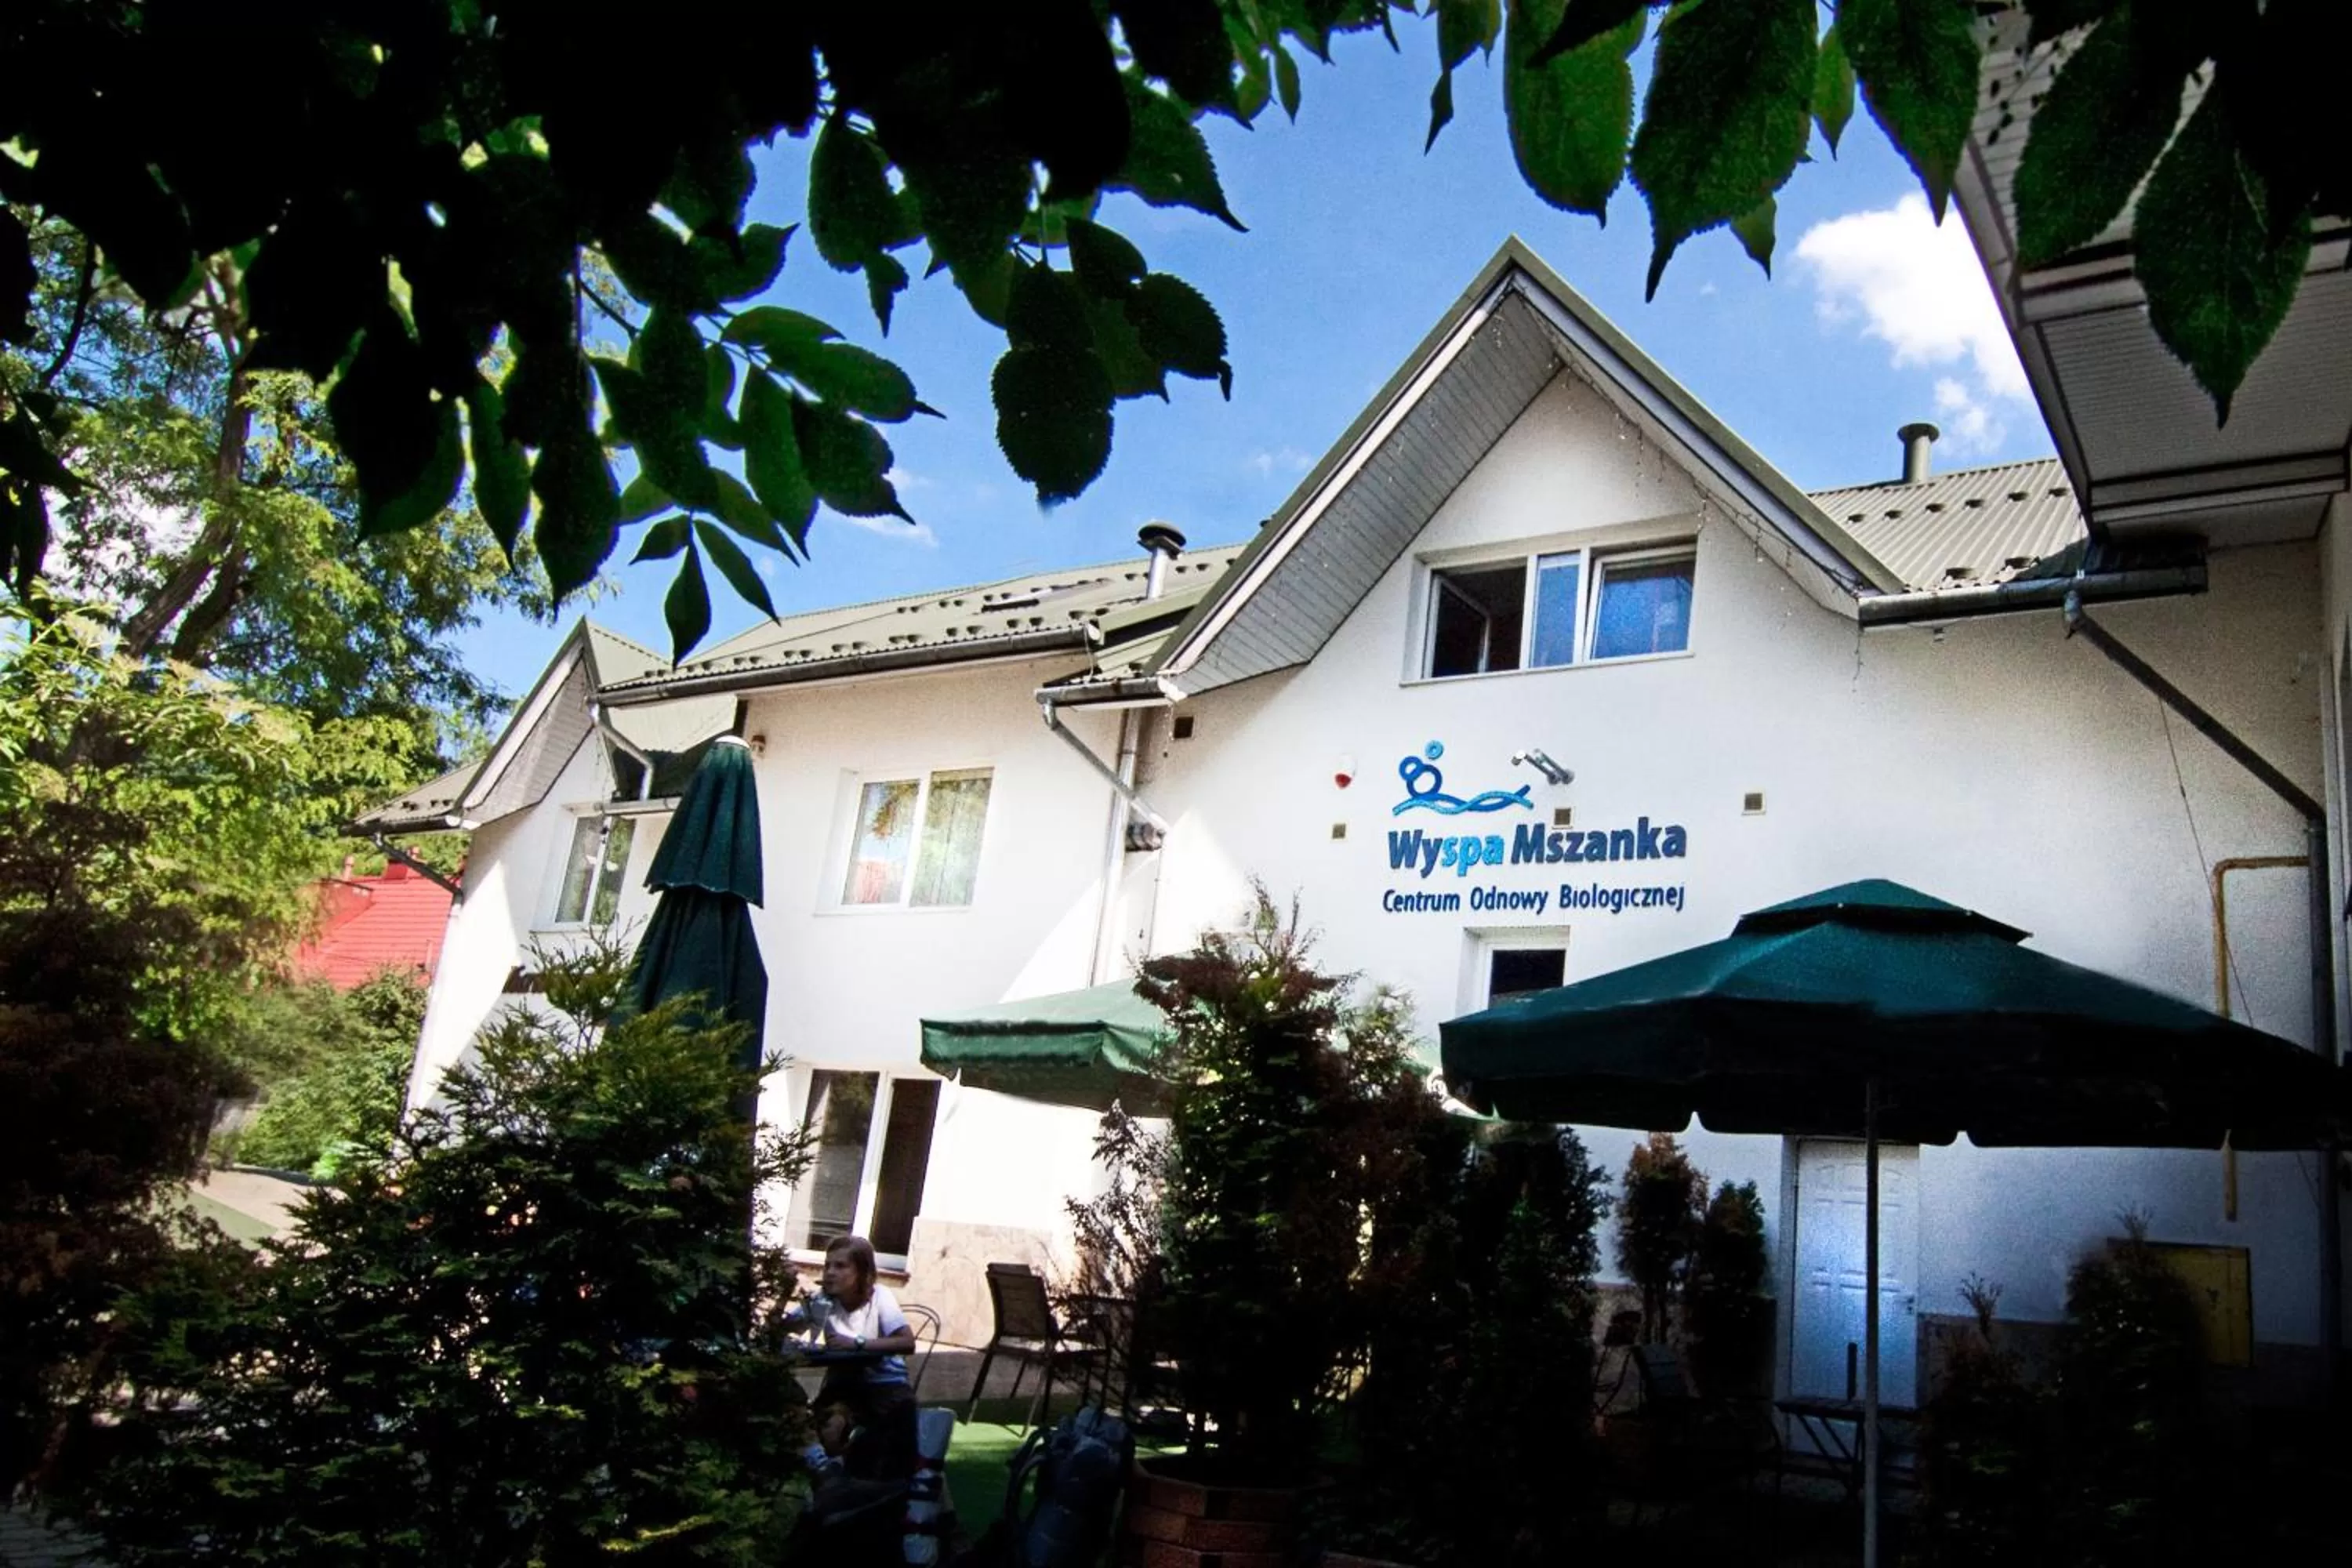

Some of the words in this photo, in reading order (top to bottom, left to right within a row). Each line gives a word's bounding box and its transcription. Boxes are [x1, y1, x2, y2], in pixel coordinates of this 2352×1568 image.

[1388, 829, 1504, 877] Wyspa
[1512, 816, 1686, 864] Mszanka
[1383, 888, 1460, 912] Centrum
[1470, 886, 1548, 914] Odnowy
[1559, 883, 1685, 914] Biologicznej
